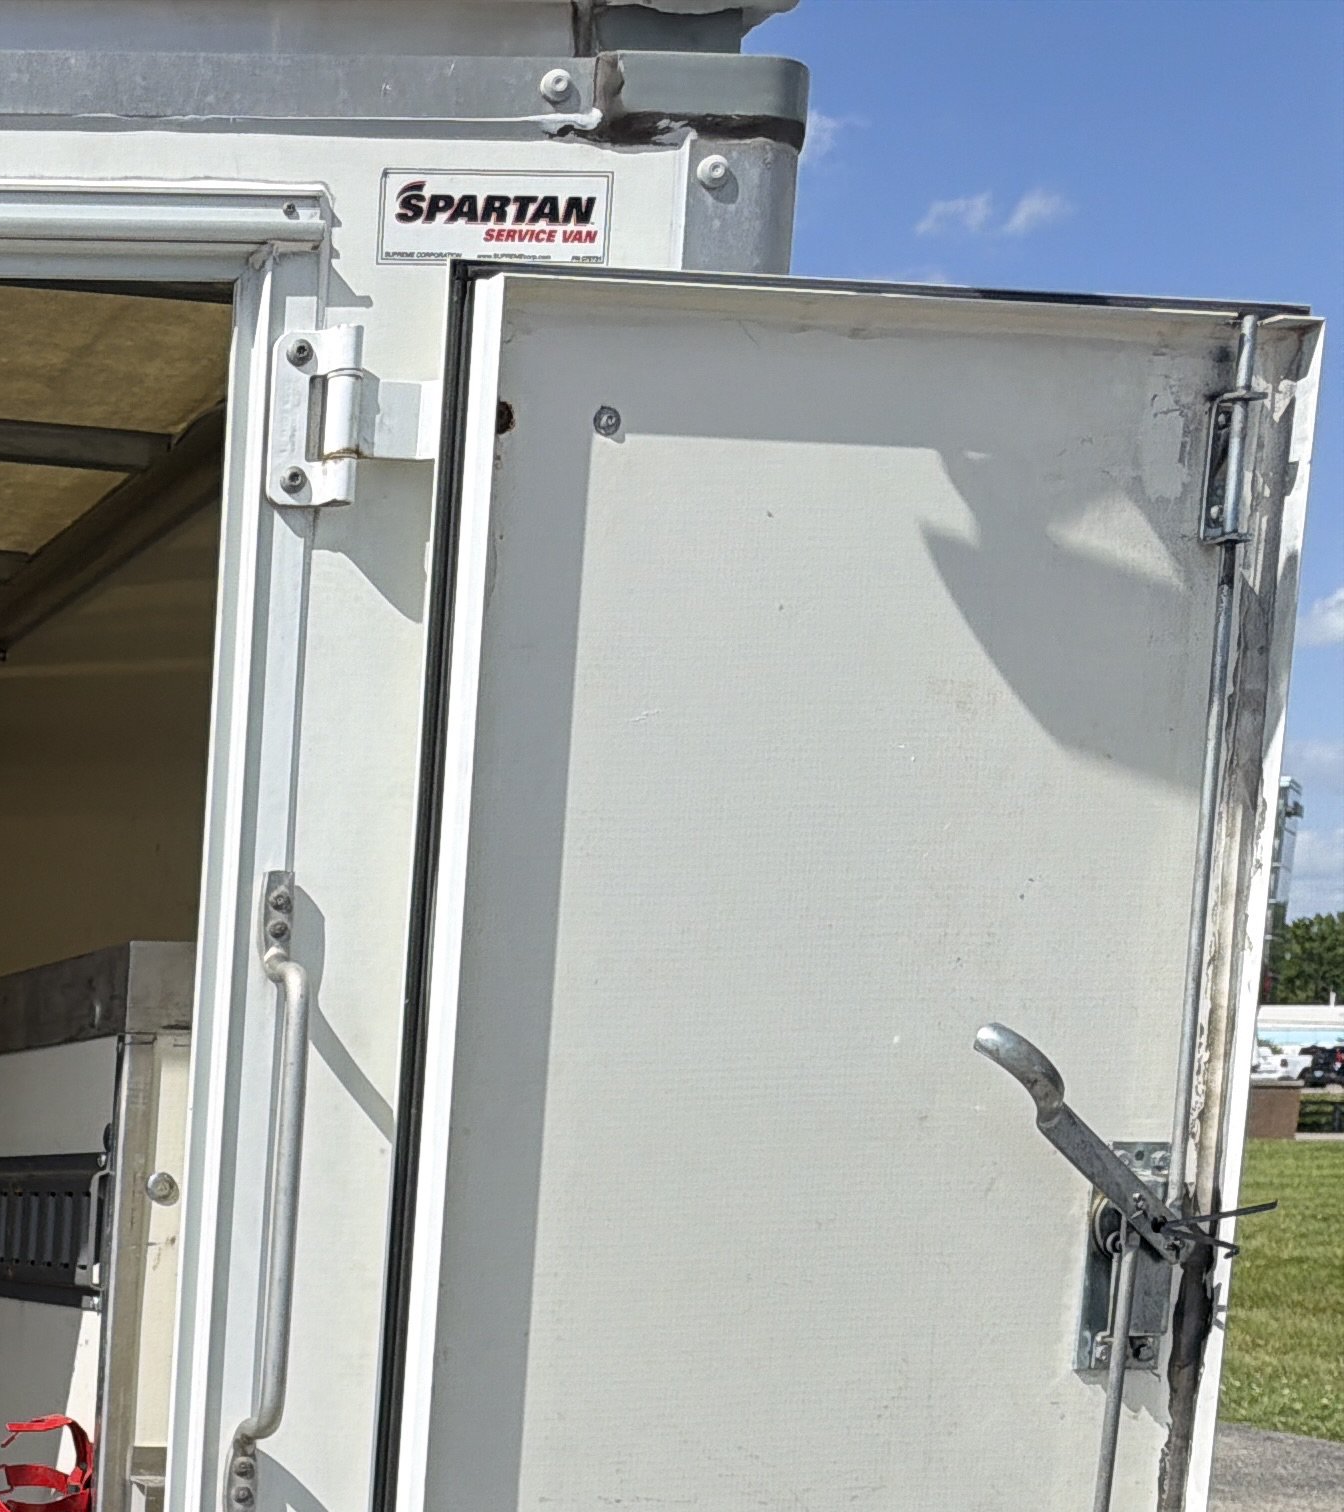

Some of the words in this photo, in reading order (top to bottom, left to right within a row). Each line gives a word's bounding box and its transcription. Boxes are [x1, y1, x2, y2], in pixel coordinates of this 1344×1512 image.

[395, 183, 596, 226] SPARTAN
[483, 228, 558, 243] SERVICE
[561, 229, 599, 244] VAN
